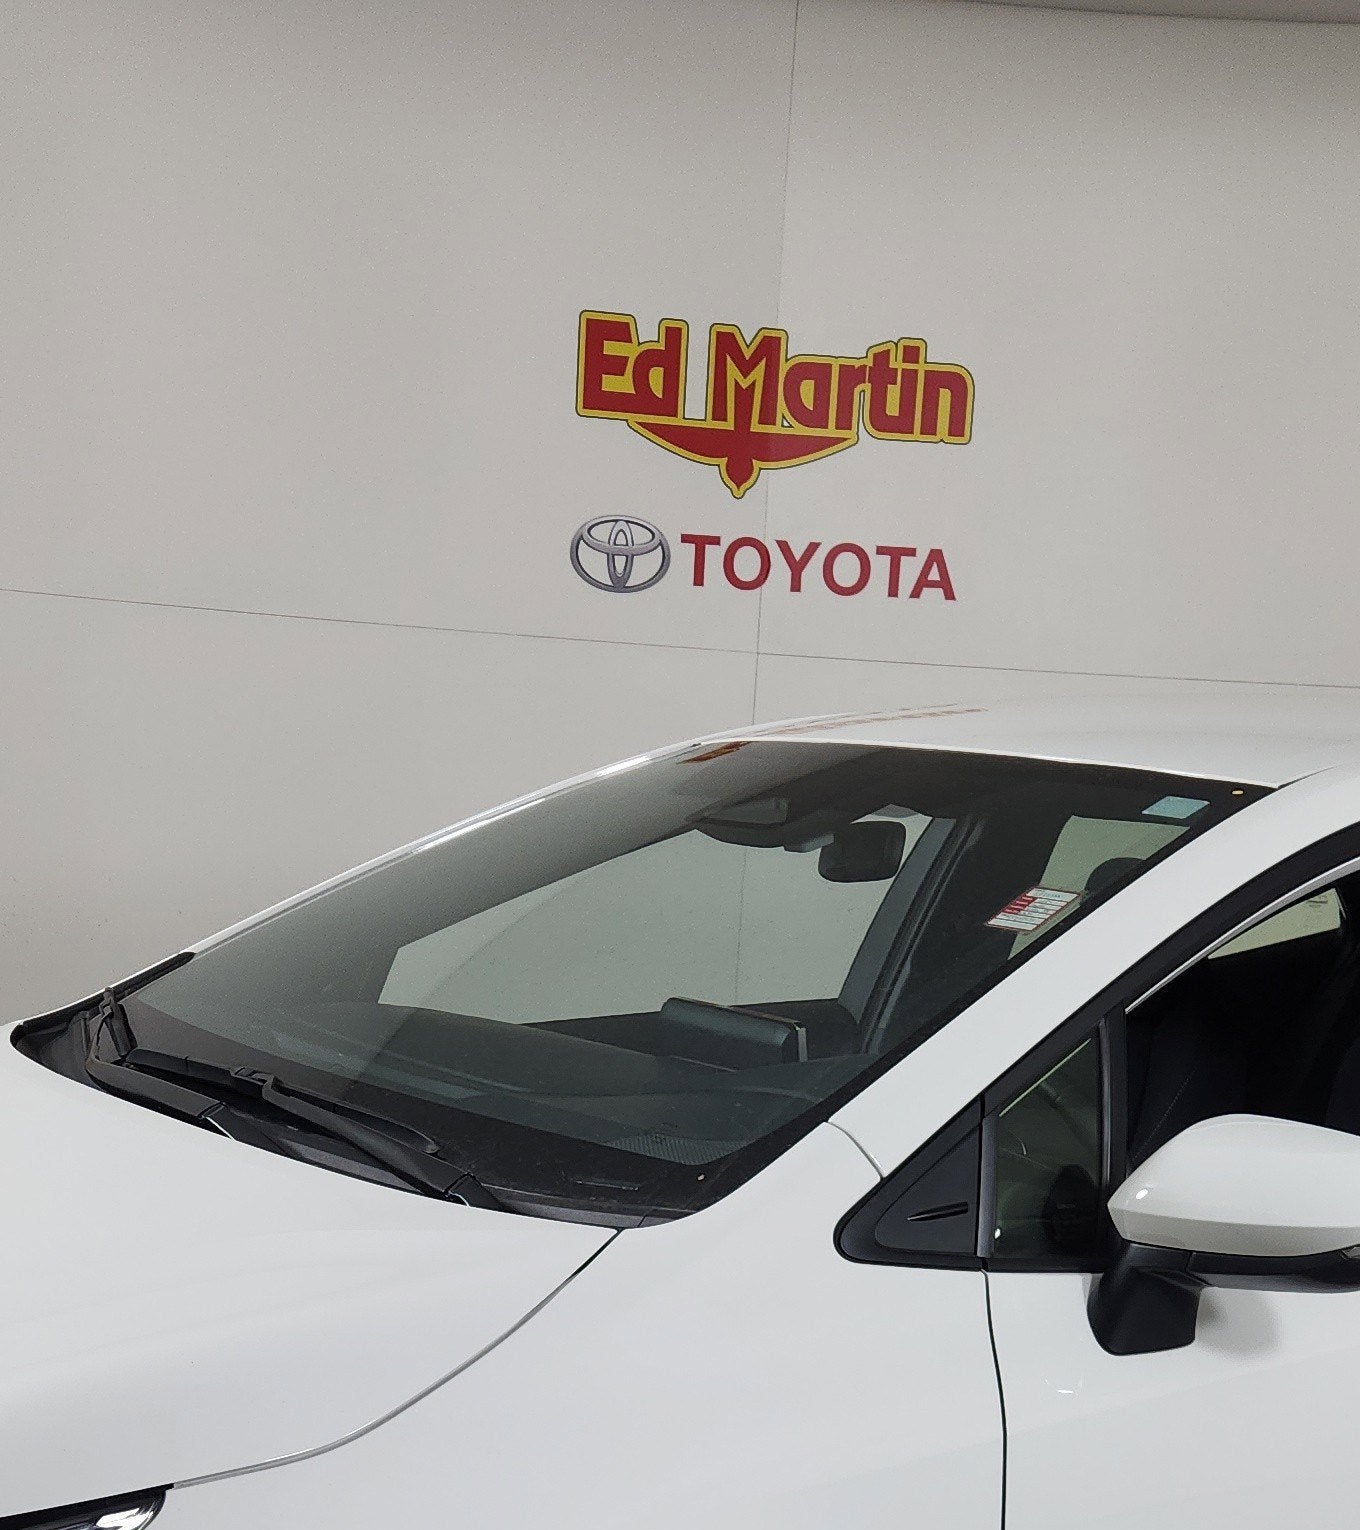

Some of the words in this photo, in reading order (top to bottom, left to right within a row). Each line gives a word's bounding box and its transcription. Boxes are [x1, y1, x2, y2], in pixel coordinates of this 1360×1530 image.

[576, 310, 688, 421] Ed
[706, 324, 975, 445] Martin
[681, 534, 956, 601] TOYOTA
